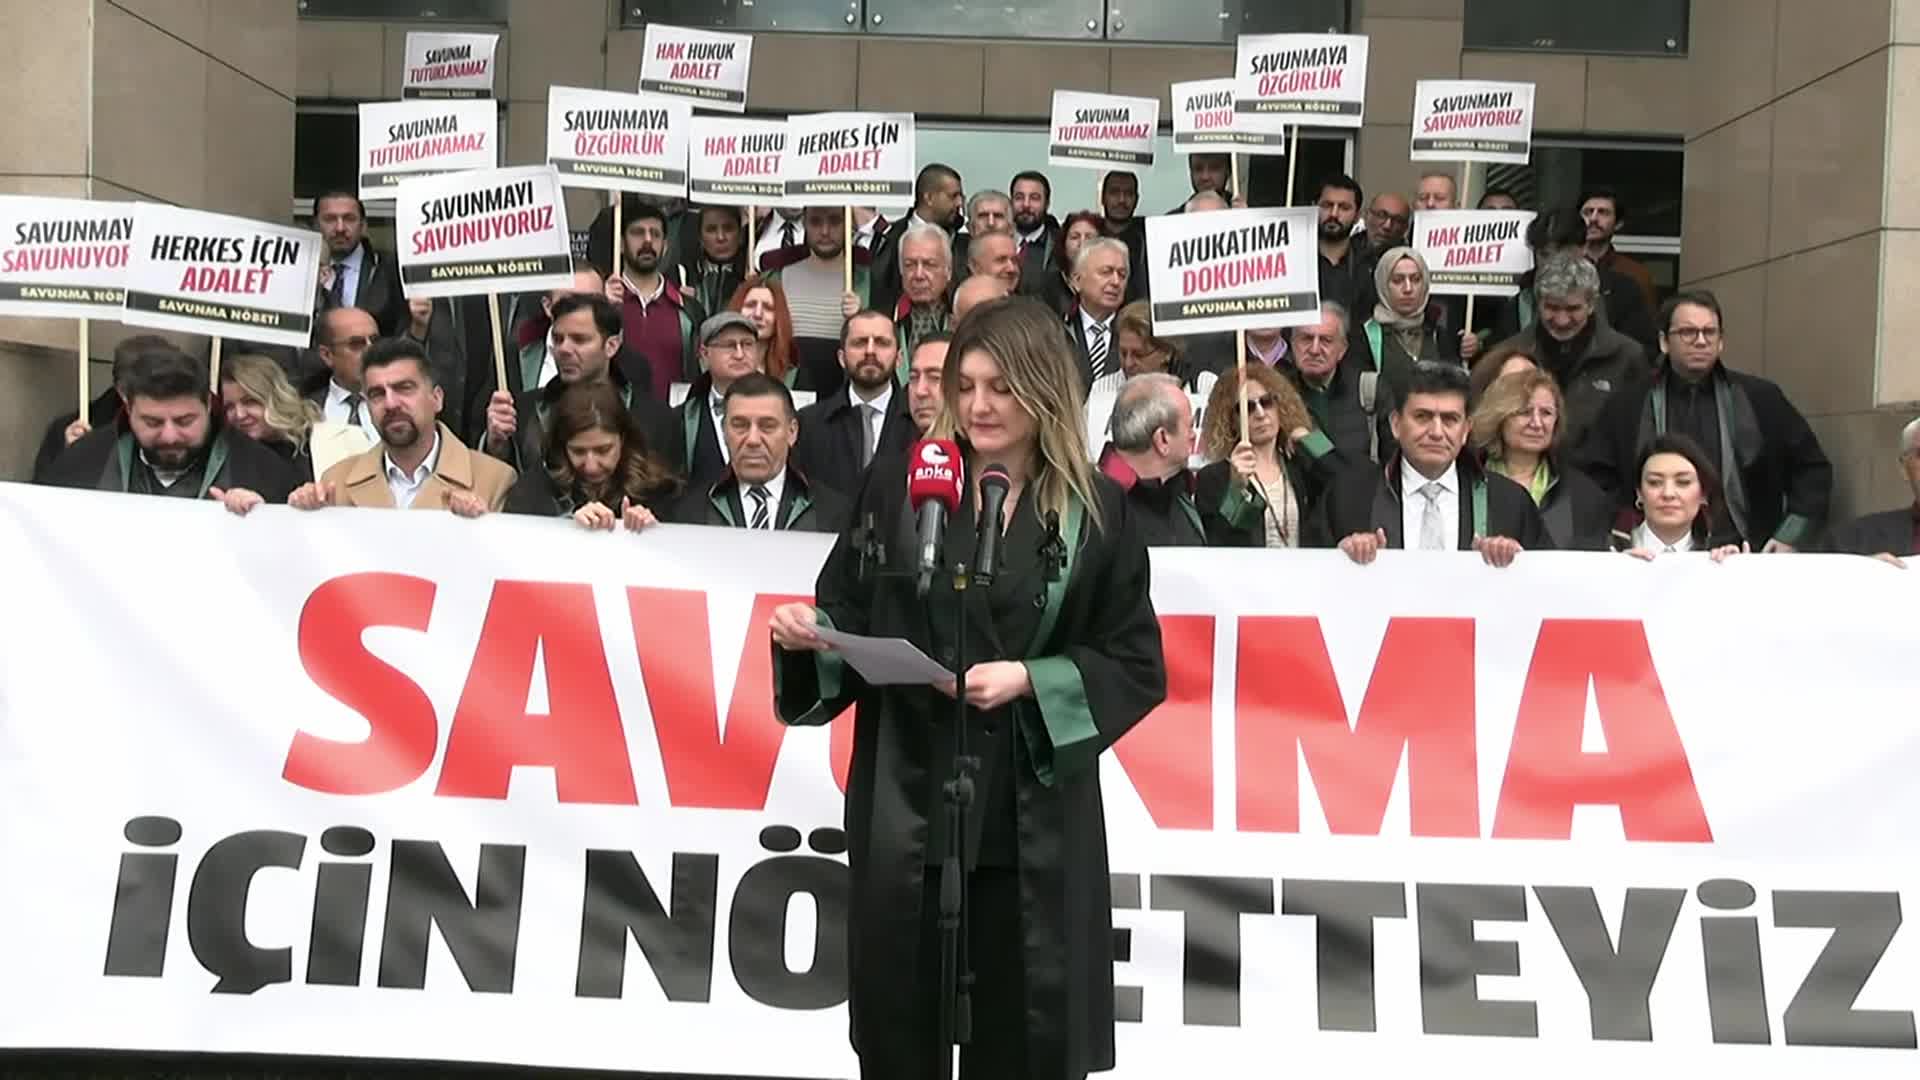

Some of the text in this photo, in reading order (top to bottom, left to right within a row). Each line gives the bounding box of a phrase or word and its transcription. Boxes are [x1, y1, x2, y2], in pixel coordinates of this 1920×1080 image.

[425, 44, 471, 65] SAVUNMA
[656, 43, 735, 60] HAK HUKUK
[1250, 45, 1347, 75] SAVUNMAYA
[410, 59, 488, 83] TUTUKLANAMAZ
[670, 62, 722, 80] ADALET
[1258, 66, 1343, 96] ÖZGÜRLÜK
[1185, 91, 1233, 112] AVUKA
[1432, 91, 1513, 114] SAVUNMAYI
[564, 109, 669, 132] SAVUNMAYA
[1075, 108, 1130, 124] SAVUNMA
[1194, 110, 1233, 129] DOKU
[1423, 108, 1523, 133] SAVUNUYORUZ
[388, 115, 458, 144] SAVUNMA
[798, 121, 899, 156] HERKES İÇİN
[1058, 123, 1151, 142] TUTUKLANAMAZ
[369, 132, 486, 168] TUTUKLANAMAZ
[575, 131, 665, 156] ÖZGÜRLÜK
[705, 133, 785, 156] HAK HUKU
[573, 163, 624, 176] SAVUNMA
[723, 155, 783, 177] ADALET
[818, 149, 882, 176] ADALET
[421, 180, 533, 226] SAVUNMAYI
[16, 218, 133, 245] SAVUNMAY
[412, 205, 554, 255] SAVUNUYORUZ
[1427, 220, 1520, 248] HAK HUKUK
[151, 234, 300, 269] HERKES İÇİN
[1168, 220, 1289, 269] AVUKATIMA
[1444, 243, 1504, 267] ADALET
[180, 266, 273, 294] ADALET
[431, 260, 543, 279] SAVUNMA NÖBETİ
[1183, 252, 1287, 297] DOKUNMA
[20, 287, 125, 302] SAVUNMA NÖB
[1182, 297, 1289, 315] SAVUNMA NÖBETİ
[158, 299, 280, 326] SAVUNMA NÖBETİ
[915, 464, 953, 480] anka
[281, 571, 1714, 843] SAVNMA
